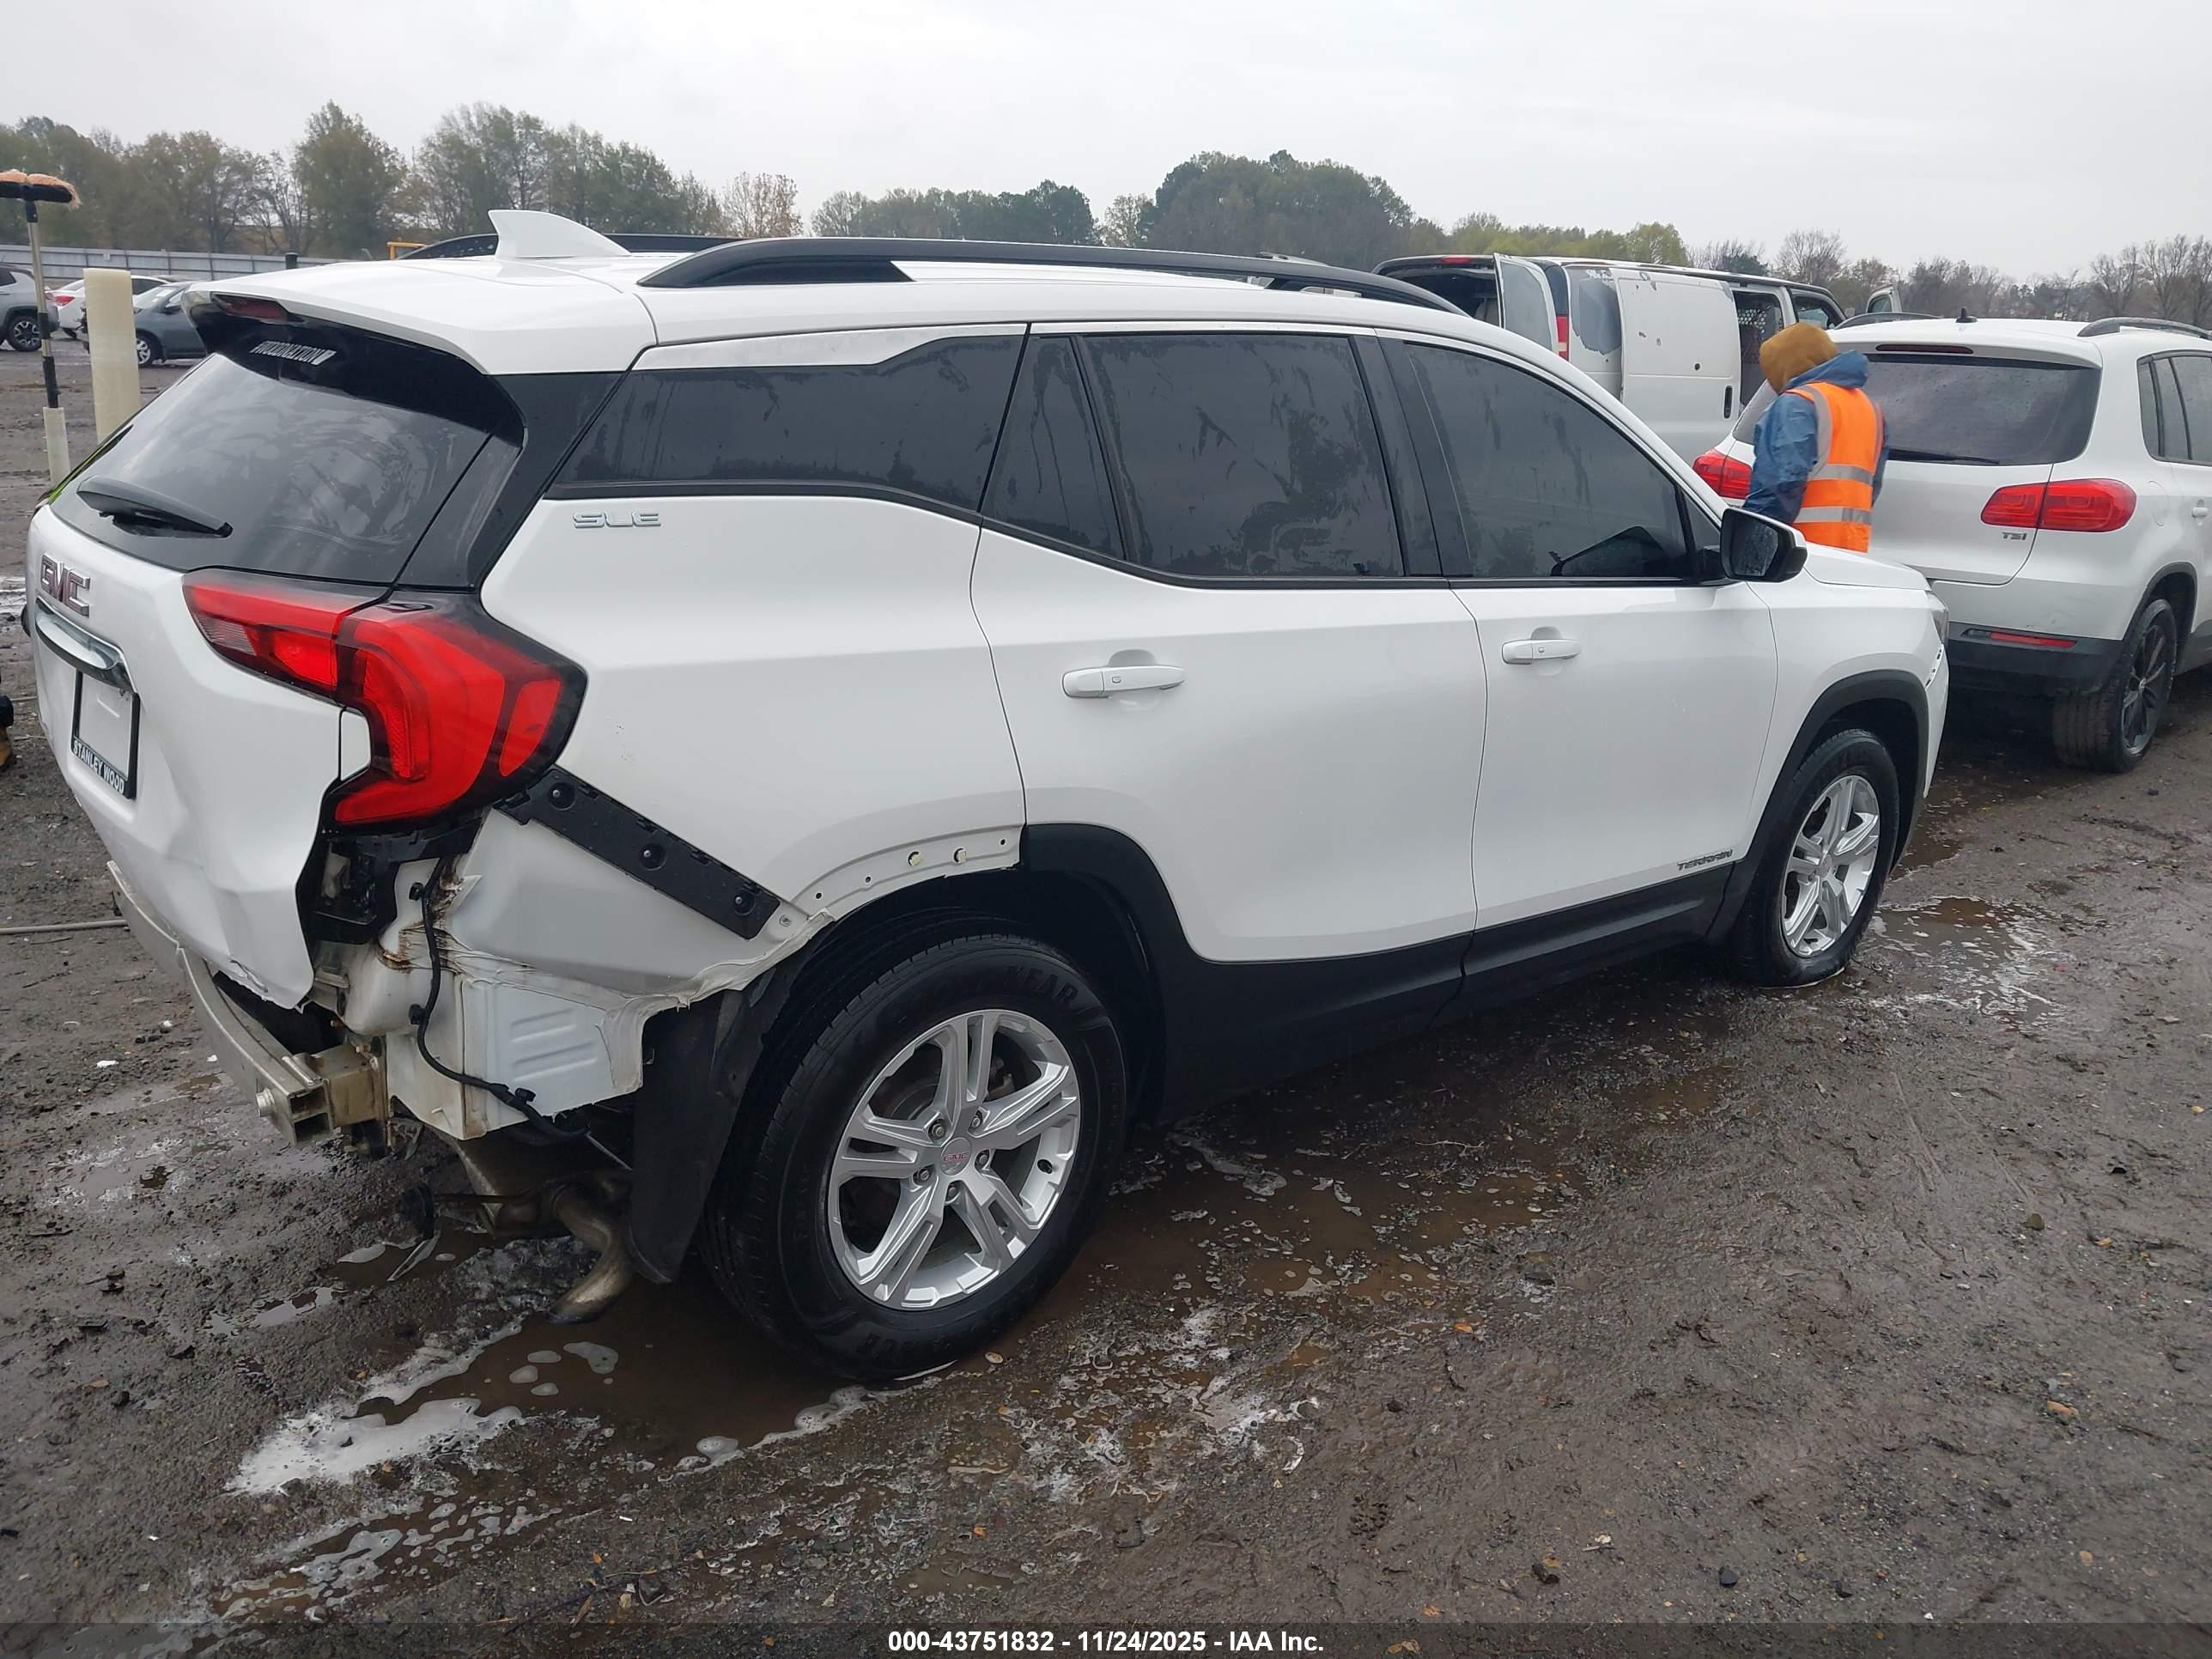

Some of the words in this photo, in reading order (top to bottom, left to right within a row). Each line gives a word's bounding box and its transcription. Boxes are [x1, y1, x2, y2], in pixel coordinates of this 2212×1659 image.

[573, 512, 661, 528] SLE
[2002, 532, 2027, 541] TSI
[40, 552, 91, 618] GMC
[73, 739, 103, 775] STANLEY
[103, 763, 125, 795] WOOD
[943, 1152, 969, 1162] GMC
